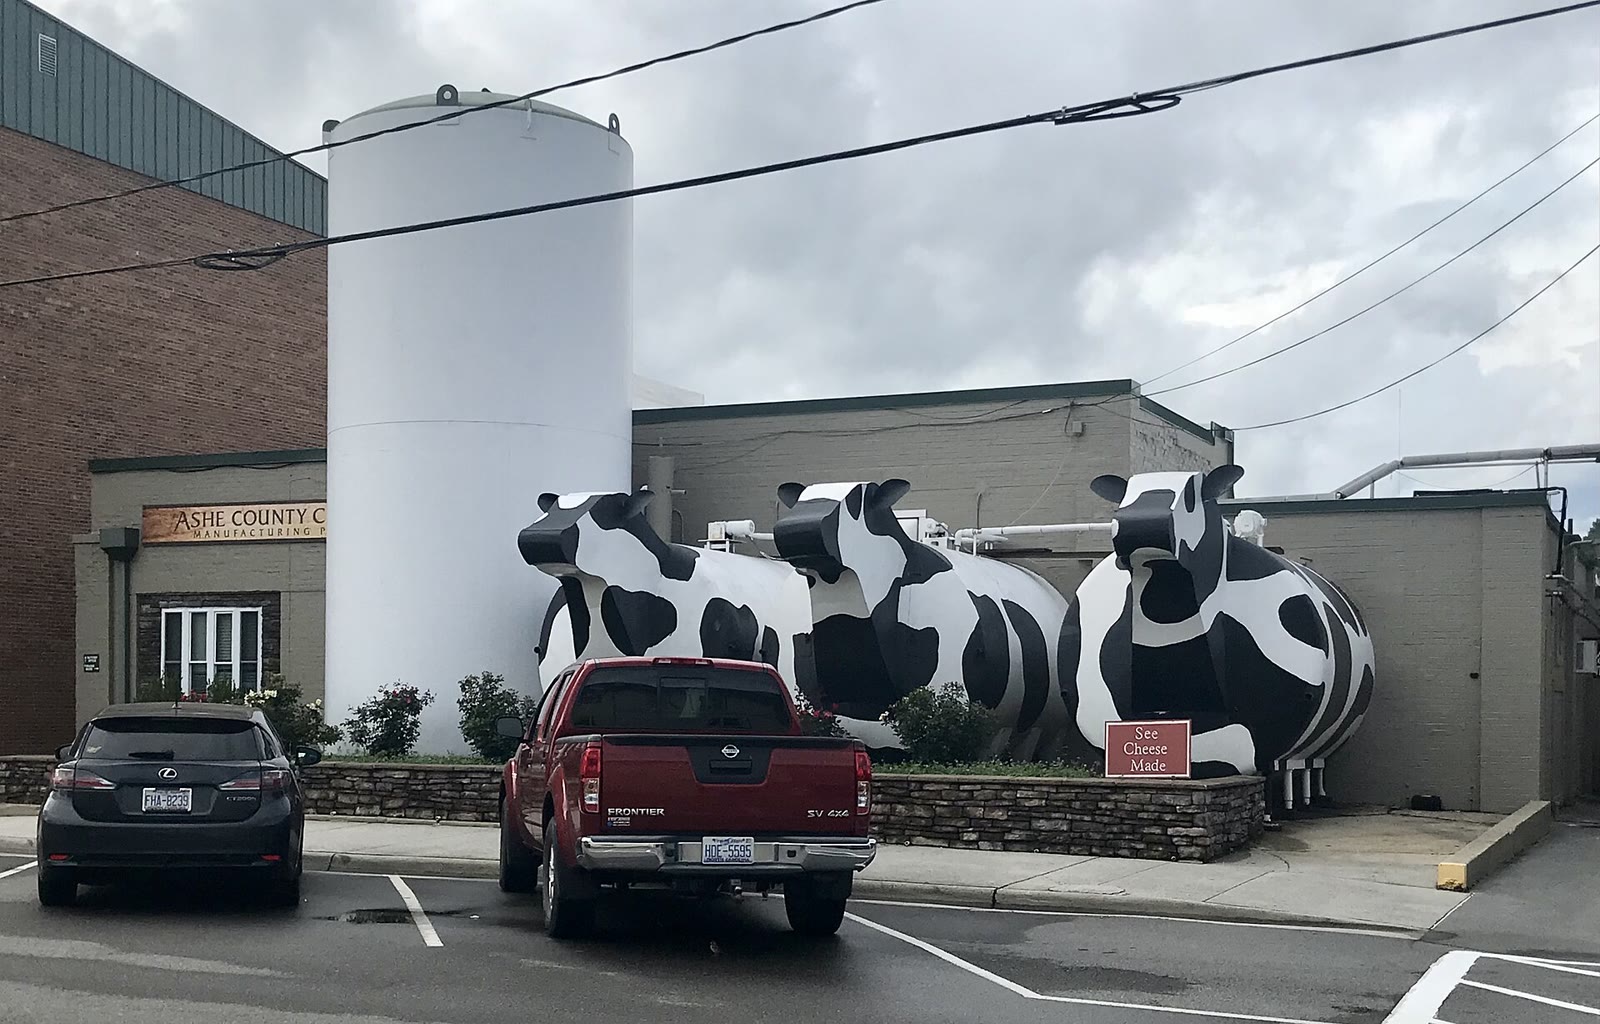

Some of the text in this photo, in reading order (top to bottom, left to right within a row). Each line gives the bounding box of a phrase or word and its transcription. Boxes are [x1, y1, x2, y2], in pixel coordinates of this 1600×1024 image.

[174, 511, 226, 532] ASHE
[231, 508, 308, 527] COUNTY
[193, 527, 310, 539] MANUFACTURING
[1134, 726, 1159, 740] See
[1123, 741, 1168, 755] Cheese
[1130, 759, 1167, 772] Made
[145, 794, 189, 807] FHA-8239
[607, 808, 665, 816] FRONTIER
[807, 809, 824, 818] SV
